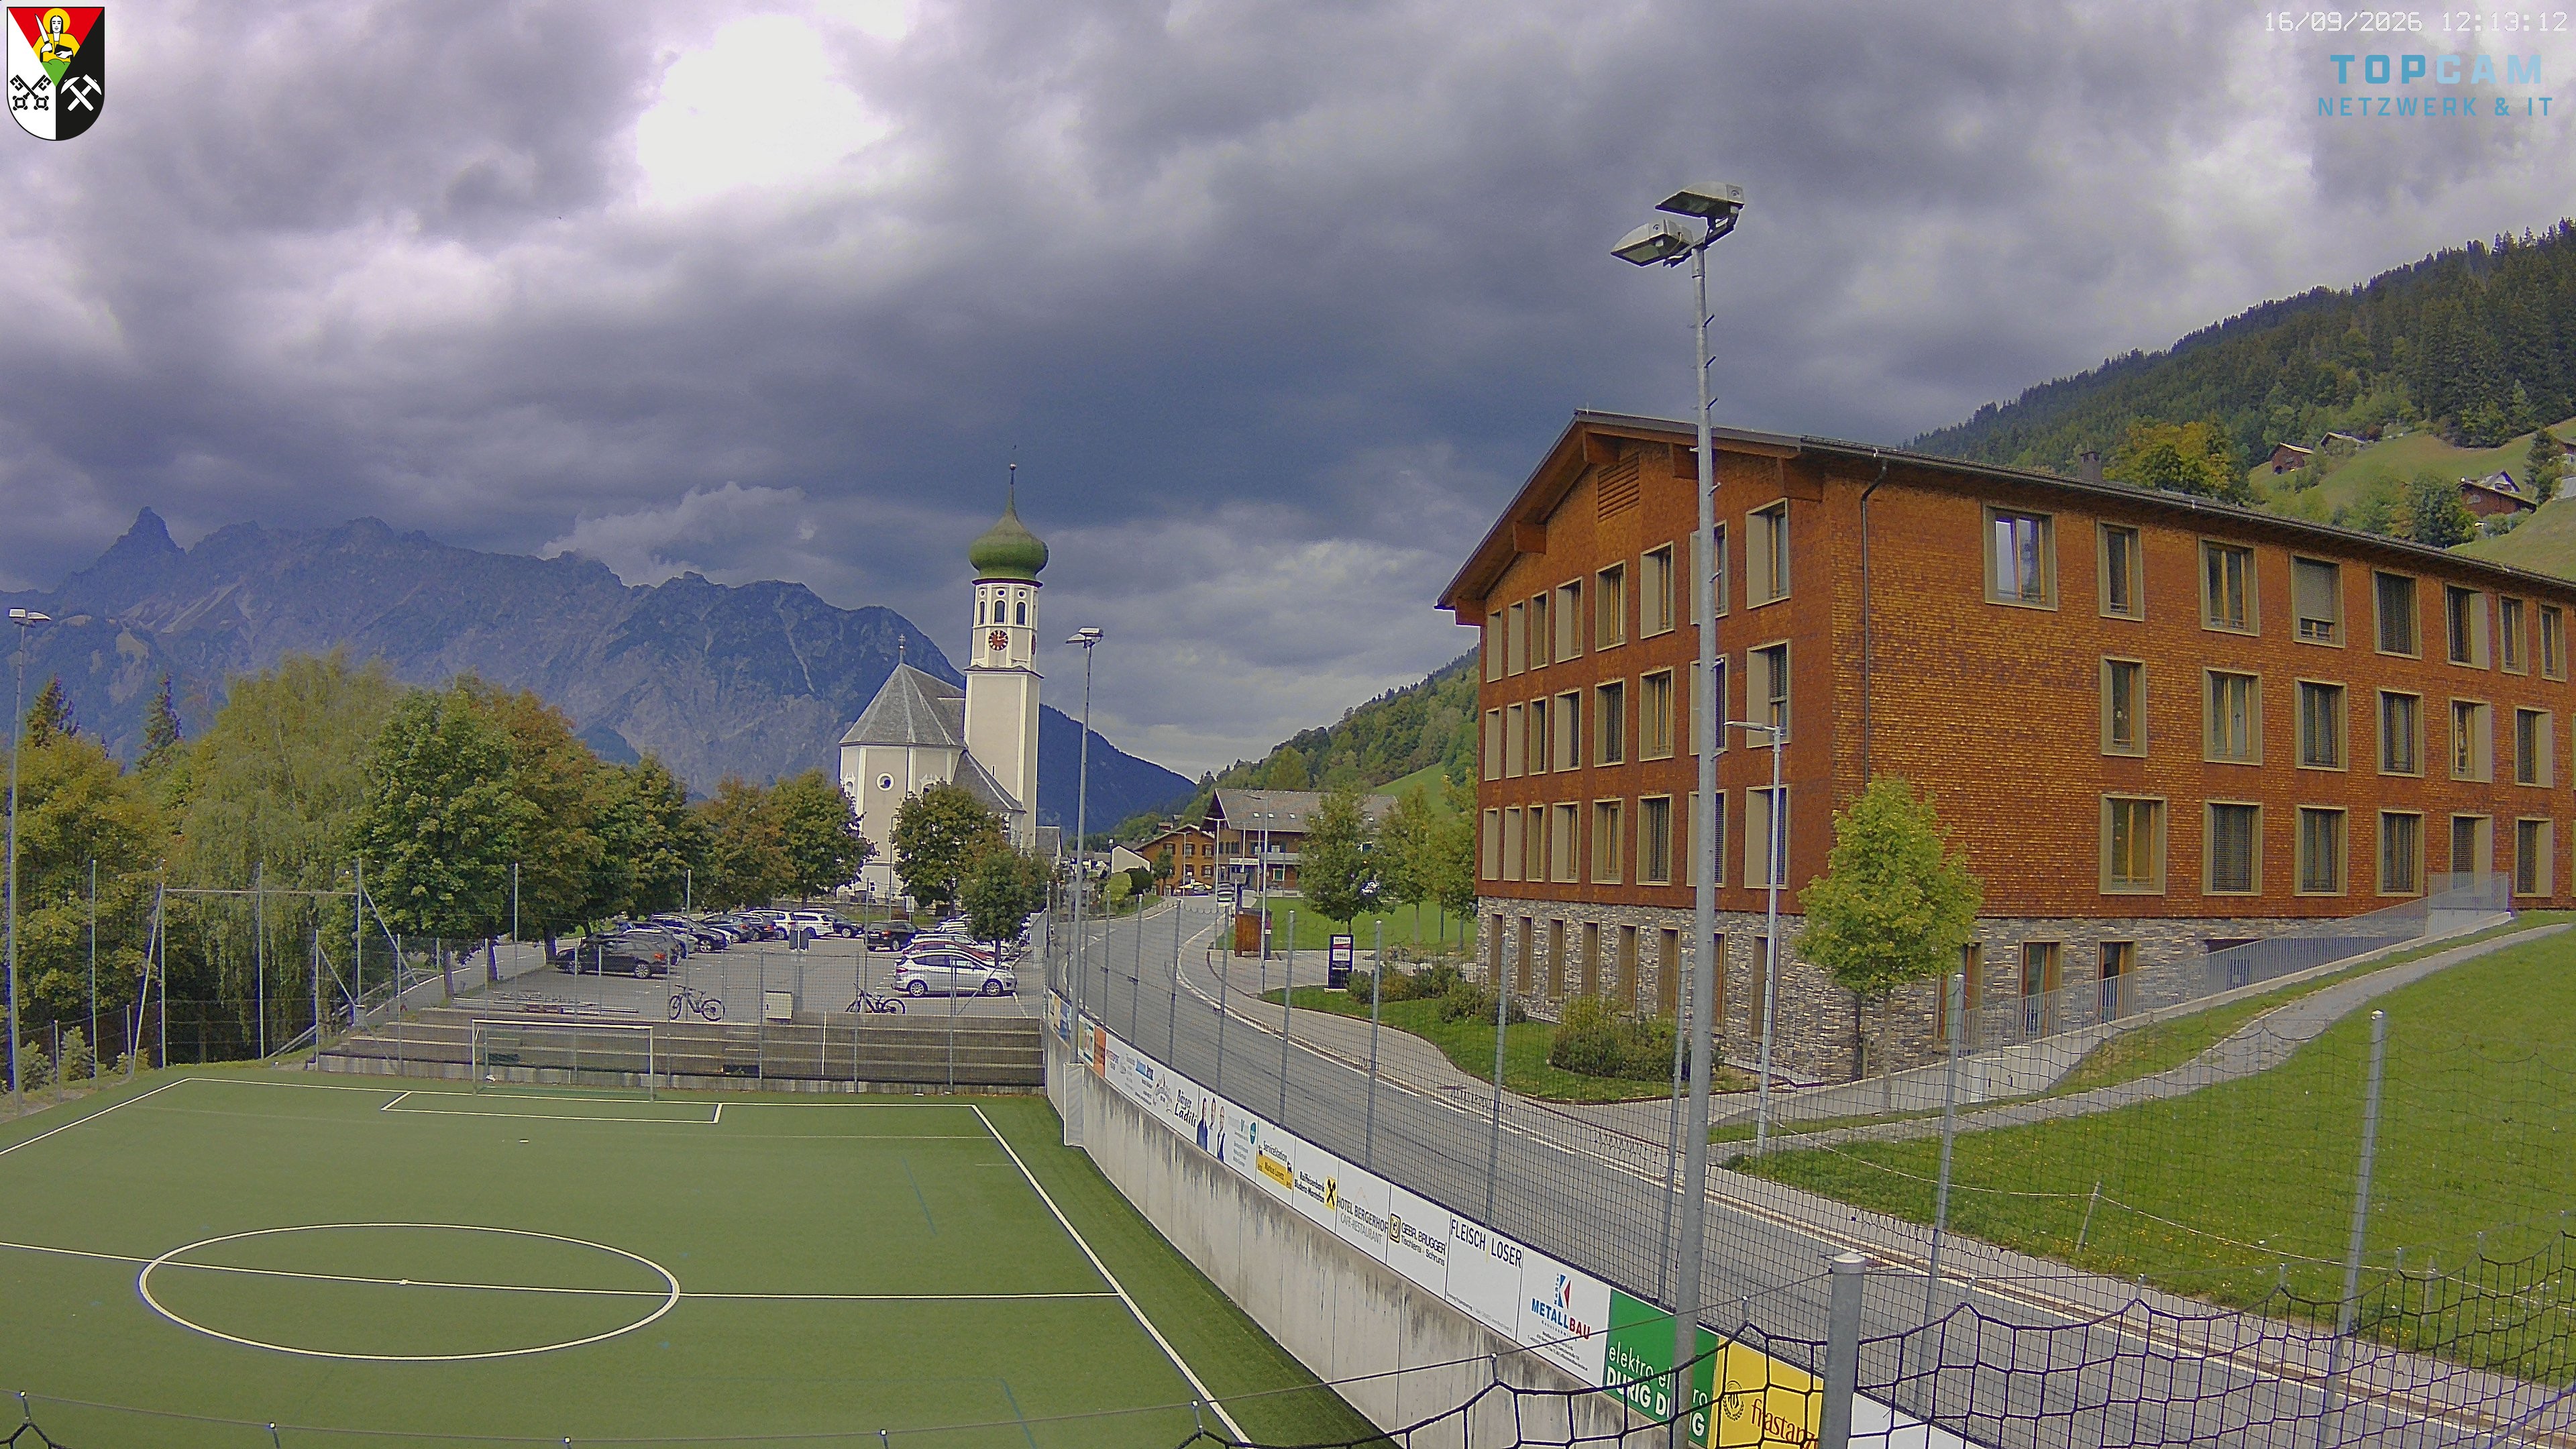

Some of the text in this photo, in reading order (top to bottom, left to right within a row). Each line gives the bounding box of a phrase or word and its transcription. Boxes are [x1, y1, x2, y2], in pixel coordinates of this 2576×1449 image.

[1300, 1171, 1325, 1193] Raiffeisenbank
[1337, 1195, 1353, 1215] HOTEL
[1401, 1222, 1446, 1256] GEBR. BRUGGER
[1450, 1219, 1522, 1269] FLEISCH LOSER
[1426, 1248, 1445, 1267] Schruns
[1531, 1297, 1591, 1340] METALLBAU
[1609, 1341, 1654, 1379] elektro
[1607, 1366, 1652, 1408] DURIG
